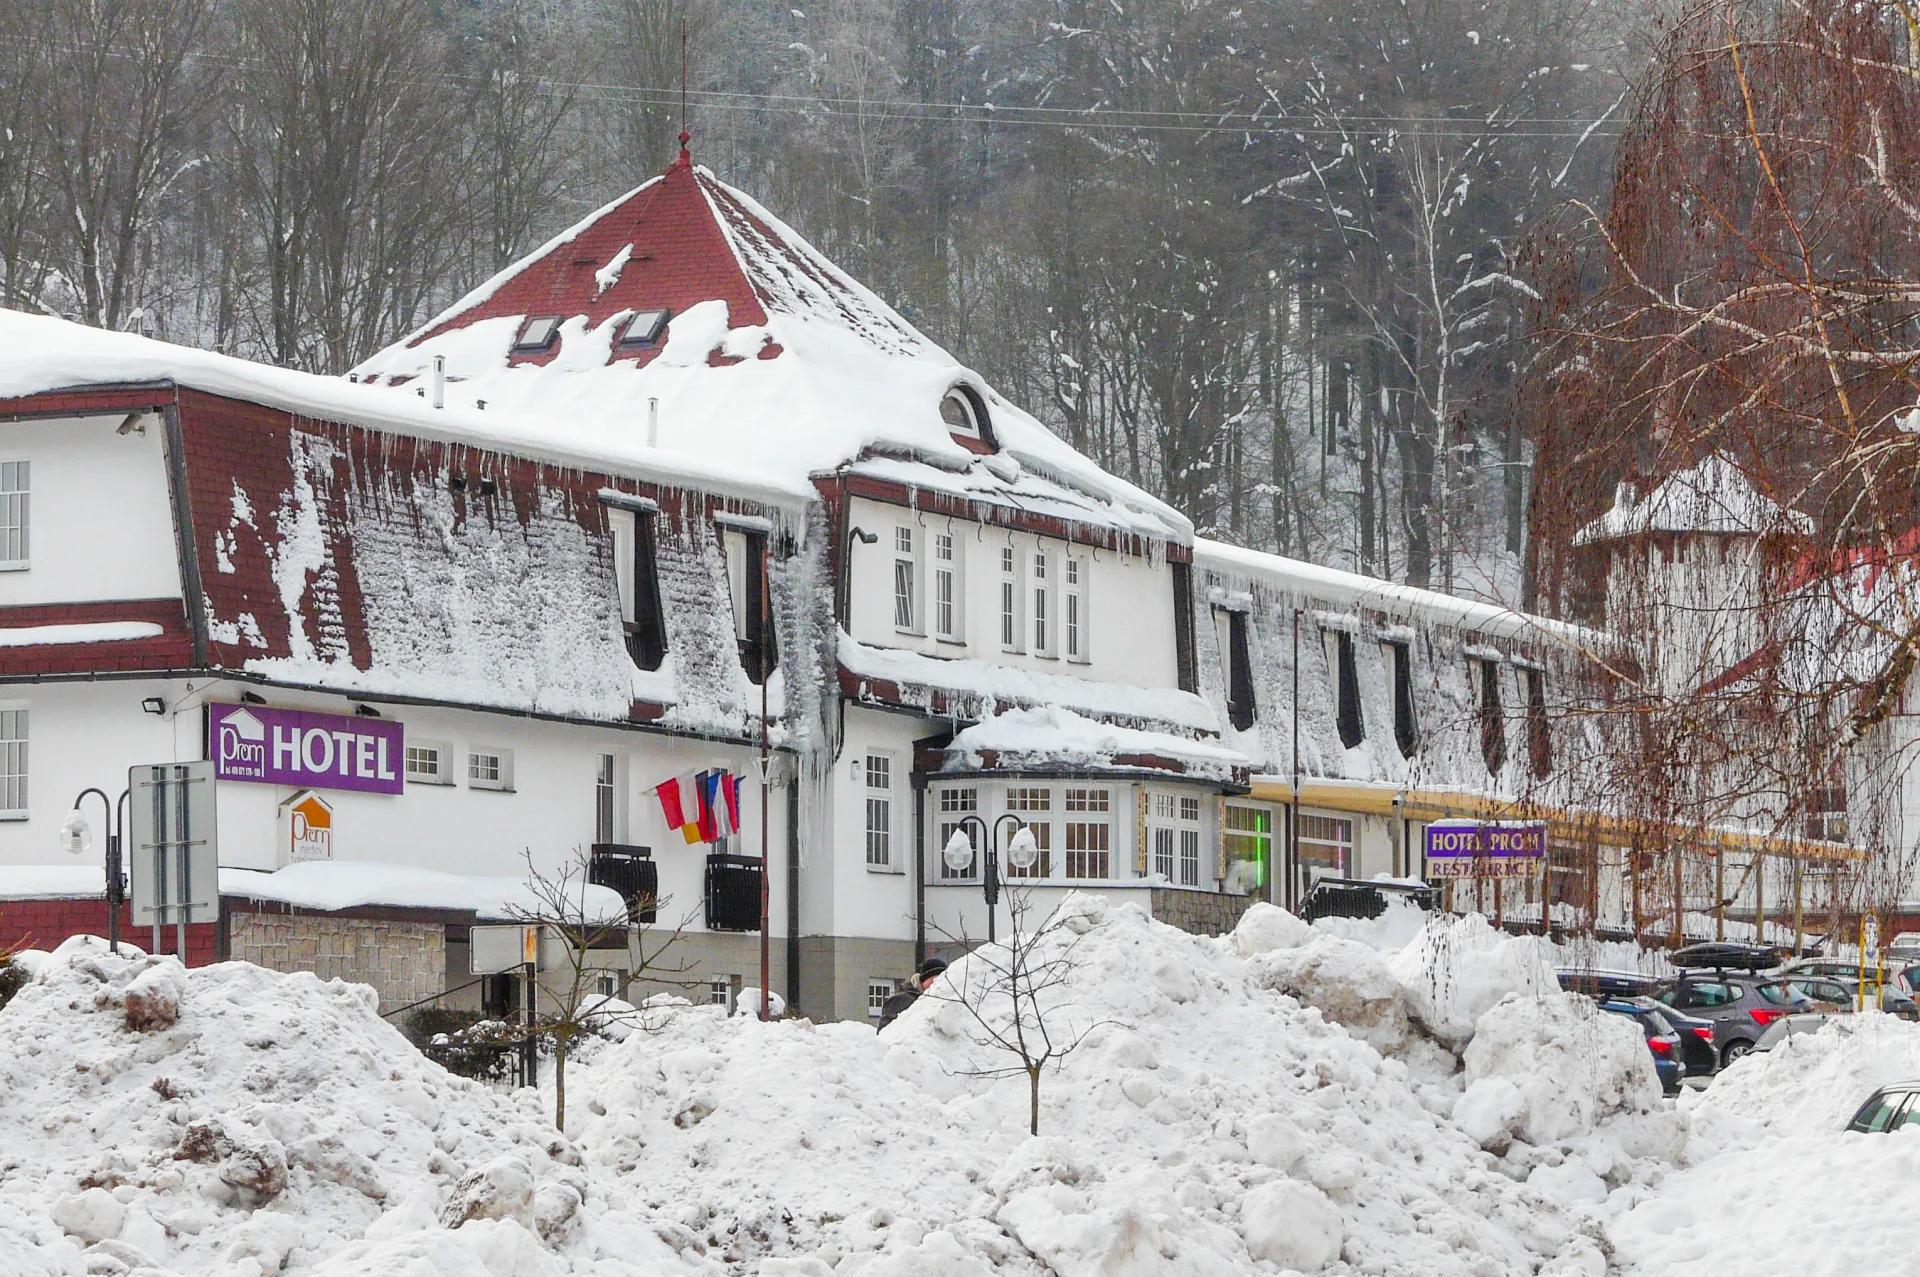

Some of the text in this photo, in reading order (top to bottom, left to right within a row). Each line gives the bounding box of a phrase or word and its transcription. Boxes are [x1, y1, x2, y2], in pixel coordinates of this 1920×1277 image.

[273, 725, 395, 780] HOTEL
[1432, 833, 1482, 851] HOTEL
[1432, 862, 1534, 877] RESTRACE
